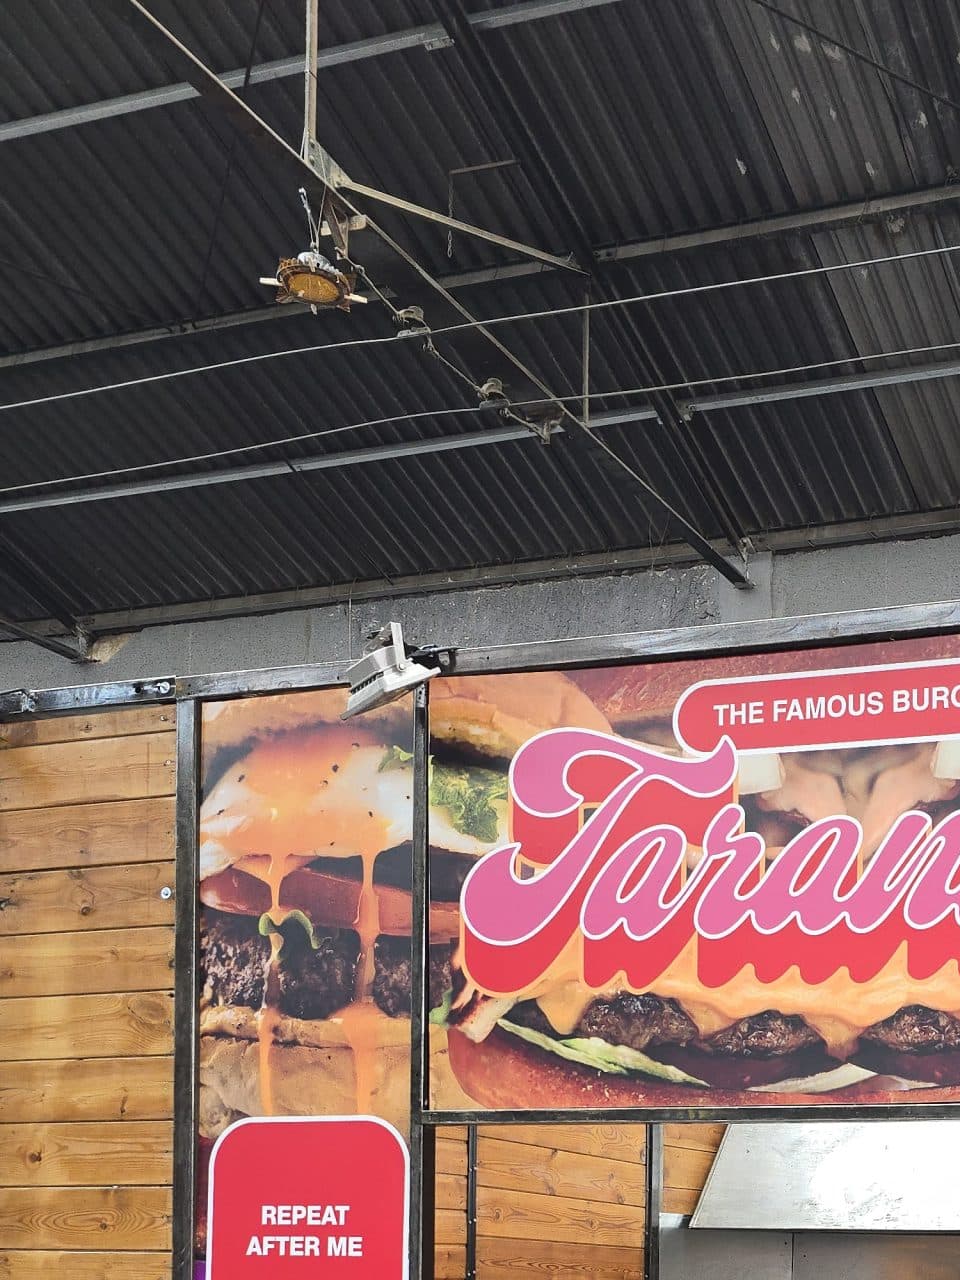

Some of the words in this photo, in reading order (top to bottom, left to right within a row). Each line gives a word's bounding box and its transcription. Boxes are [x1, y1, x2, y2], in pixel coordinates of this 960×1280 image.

[712, 701, 765, 727] THE
[772, 690, 884, 722] FAMOUS
[260, 1204, 350, 1226] REPEAT
[245, 1235, 321, 1257] AFTER
[326, 1237, 364, 1258] ME
